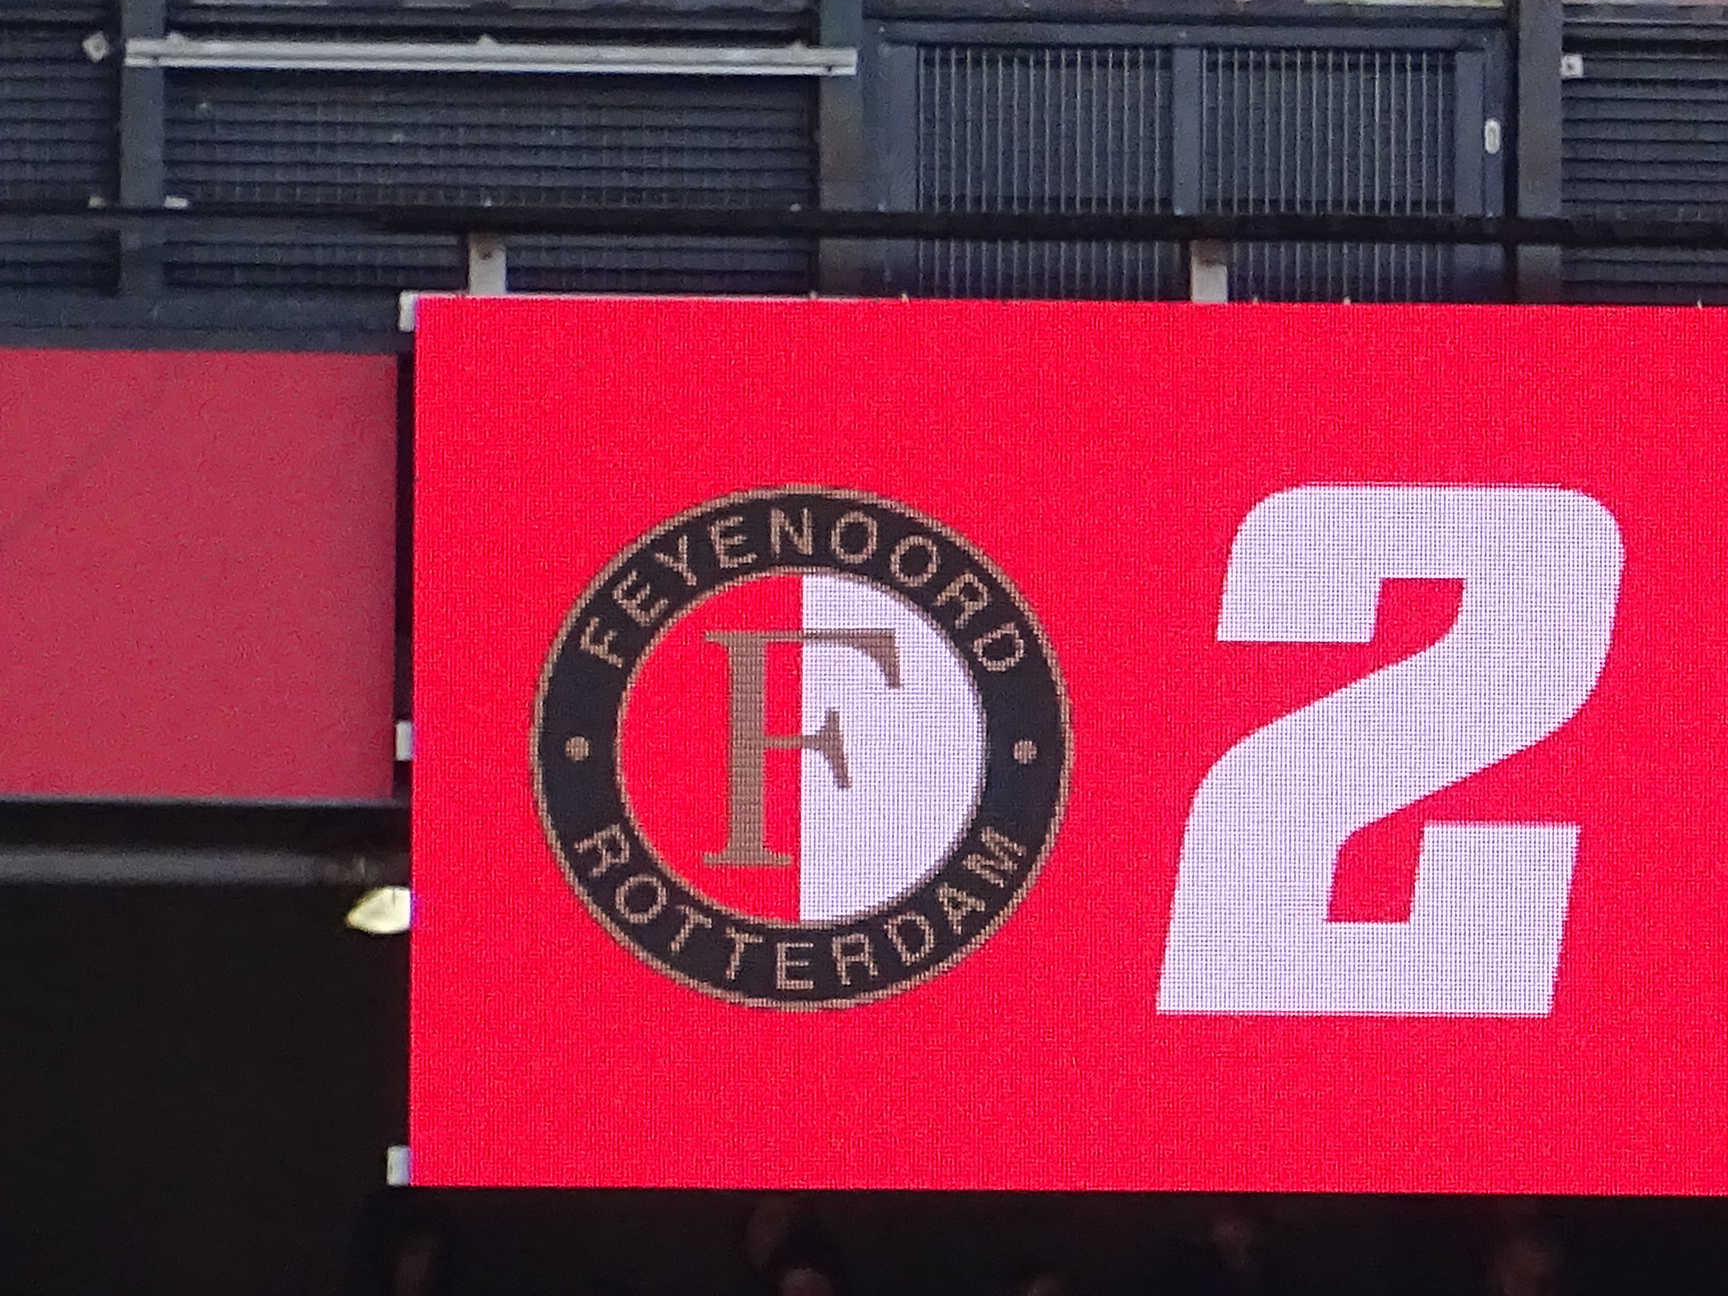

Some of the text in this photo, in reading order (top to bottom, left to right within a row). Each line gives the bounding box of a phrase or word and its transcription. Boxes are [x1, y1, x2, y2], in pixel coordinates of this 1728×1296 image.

[577, 510, 1029, 674] FEYENOORD
[704, 629, 903, 867] F
[1156, 483, 1626, 1016] 2
[571, 823, 1027, 992] ROTTERDAM
